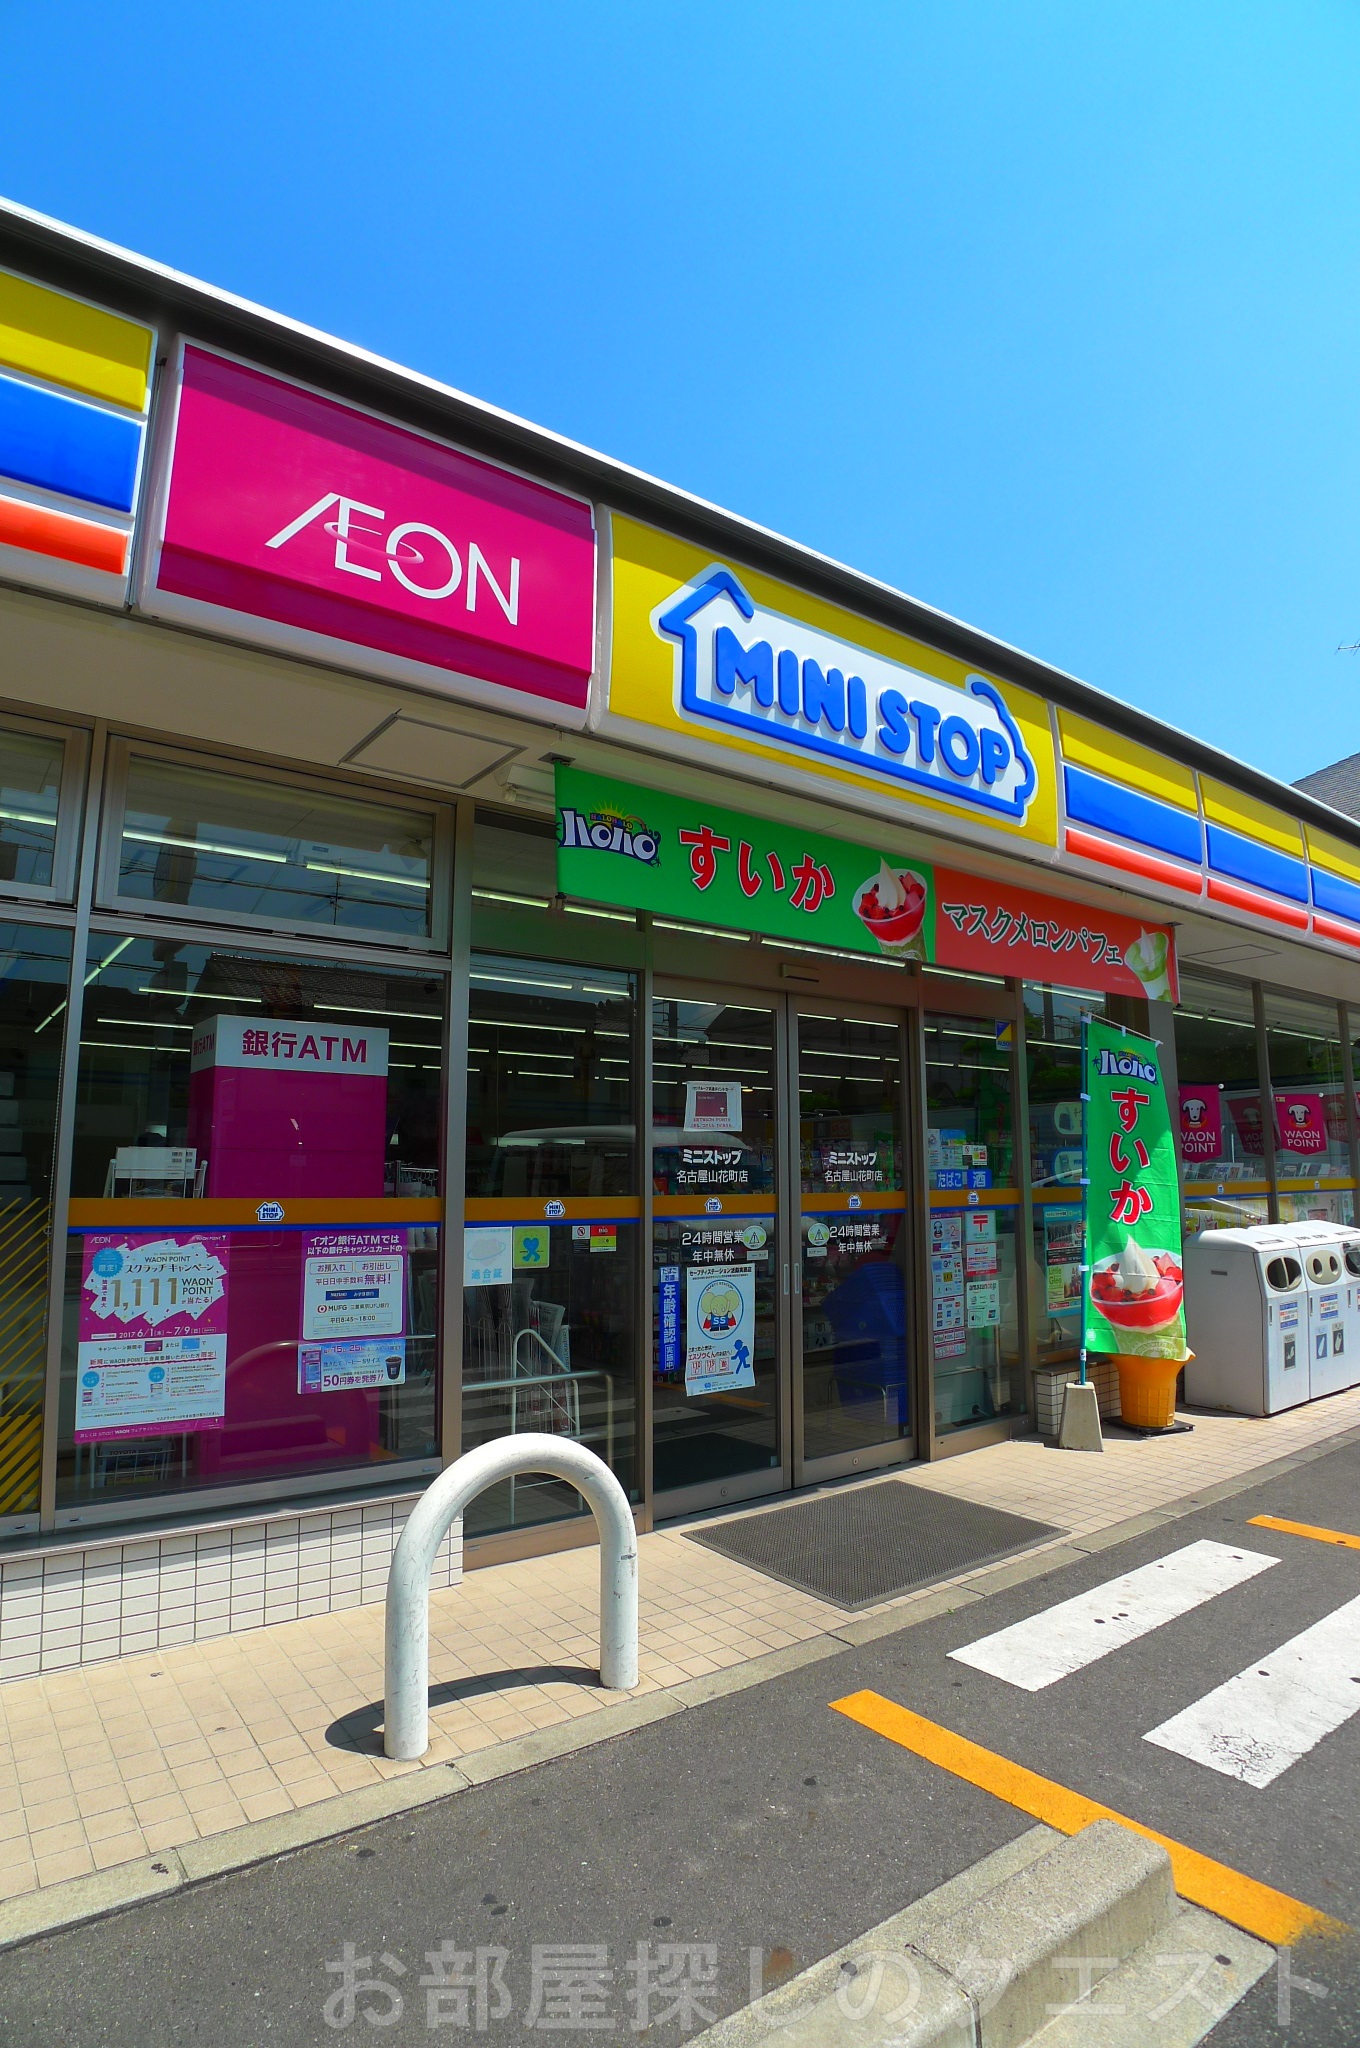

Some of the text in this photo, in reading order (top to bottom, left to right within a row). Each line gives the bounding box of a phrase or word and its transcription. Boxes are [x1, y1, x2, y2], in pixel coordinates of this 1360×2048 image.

[714, 625, 1011, 786] MINI STOP
[590, 812, 633, 830] HALOHALO
[678, 824, 836, 913] すいか
[941, 901, 1124, 966] マスクメロンパフェ
[193, 1032, 215, 1056] 銀行ATM
[242, 1029, 368, 1063] 銀行ATM
[1285, 1130, 1321, 1139] WAON
[1287, 1139, 1321, 1148] POINT
[682, 1148, 743, 1165] ミニストップ
[828, 1151, 878, 1166] ミニストップ
[1108, 1086, 1154, 1225] すいか
[676, 1169, 749, 1184] 名古屋山花町店
[824, 1170, 883, 1182] 名古屋山花町店
[937, 1172, 962, 1187] たばこ
[973, 1171, 986, 1188] 酒
[829, 1224, 881, 1238] 24時間営業
[310, 1234, 400, 1246] イオン銀行ATMでは
[838, 1241, 873, 1254] 年中無休
[307, 1244, 403, 1255] 以下の銀行キャッシュカードの
[692, 1250, 735, 1264] 年中無休
[169, 1255, 191, 1263] POINT
[361, 1262, 391, 1271] お引出し
[182, 1277, 214, 1286] WAON
[110, 1277, 178, 1311] 1,111
[182, 1286, 214, 1295] POINT
[663, 1283, 677, 1344] 年齢確認
[713, 1316, 726, 1325] SS
